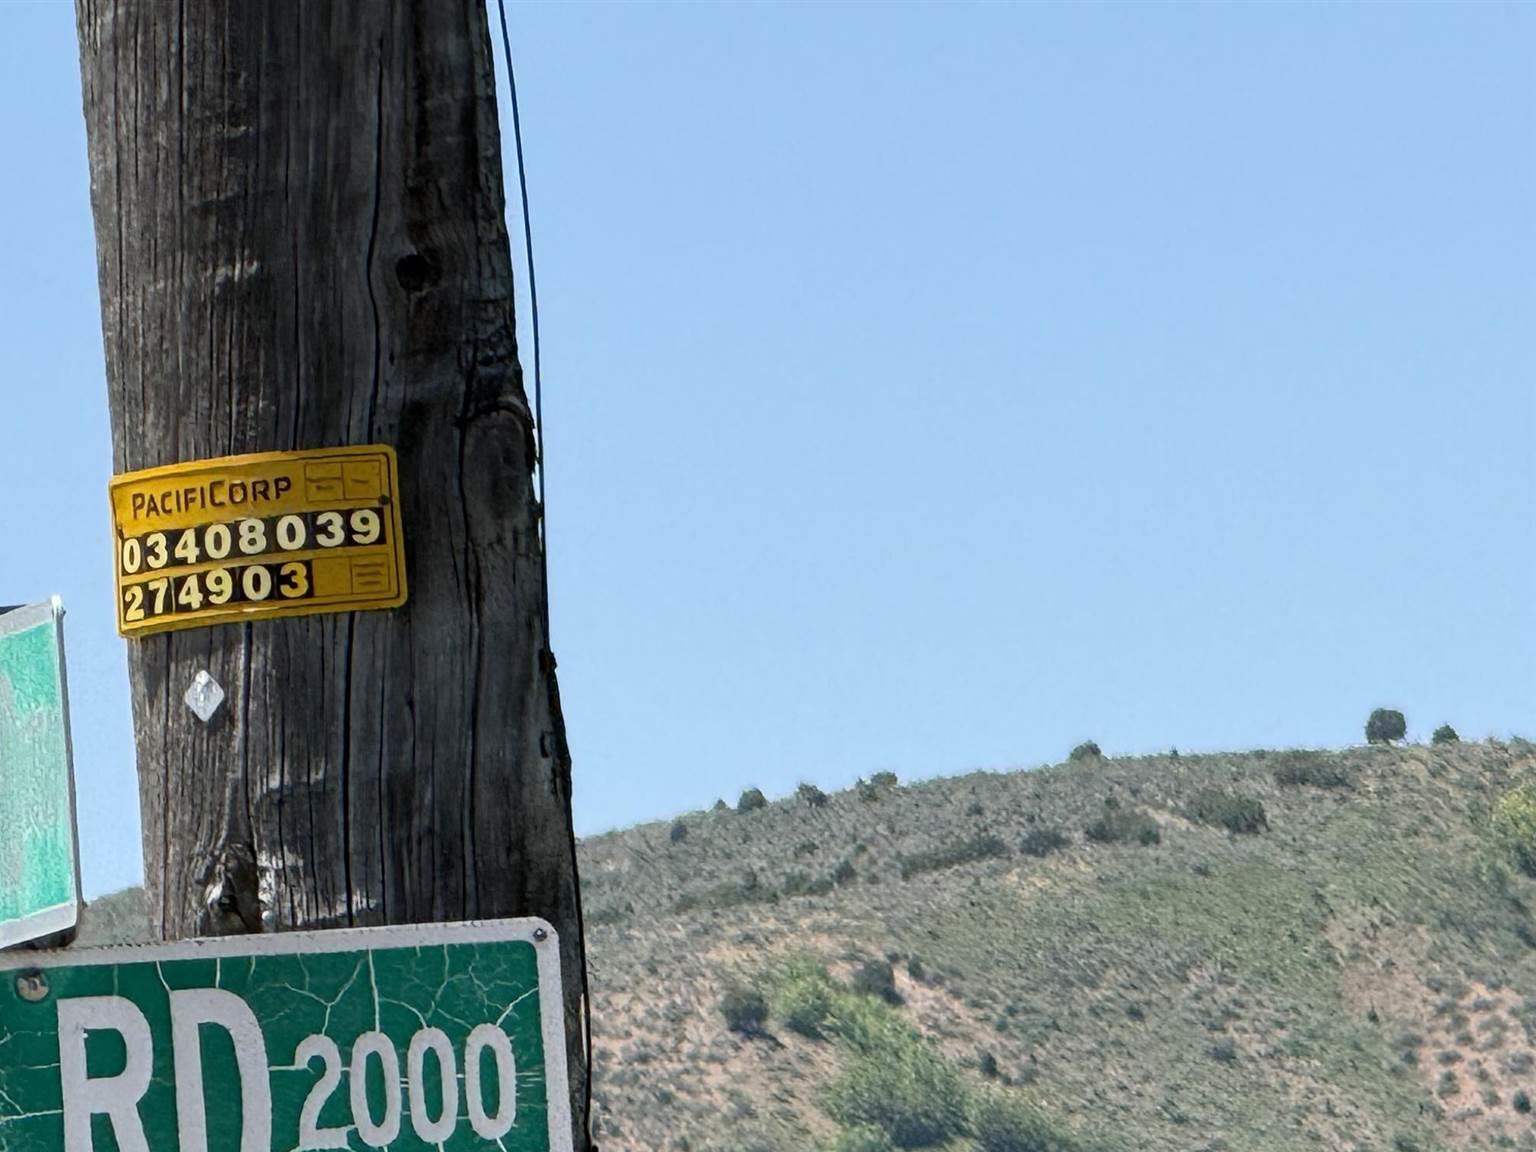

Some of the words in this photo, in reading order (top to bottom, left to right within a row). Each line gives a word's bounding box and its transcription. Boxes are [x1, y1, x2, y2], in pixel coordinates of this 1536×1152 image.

[122, 508, 381, 574] 03408039
[124, 561, 309, 622] 274903
[294, 1022, 517, 1150] 2000
